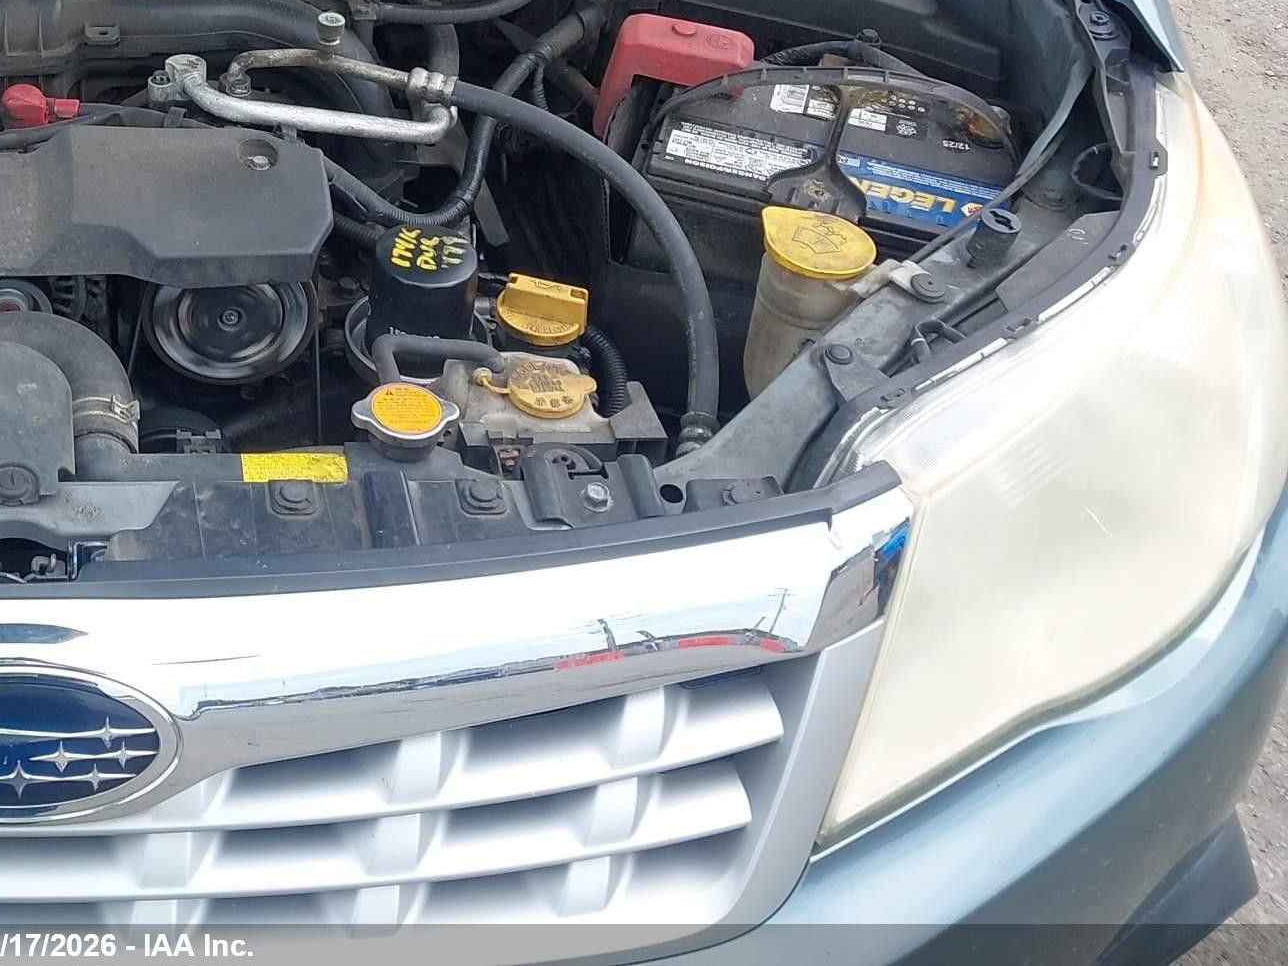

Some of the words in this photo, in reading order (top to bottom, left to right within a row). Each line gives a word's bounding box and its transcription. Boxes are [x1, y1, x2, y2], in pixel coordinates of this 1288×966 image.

[941, 139, 971, 151] 12/25
[684, 158, 767, 182] DANGER/POISON
[847, 176, 957, 213] LEGEN
